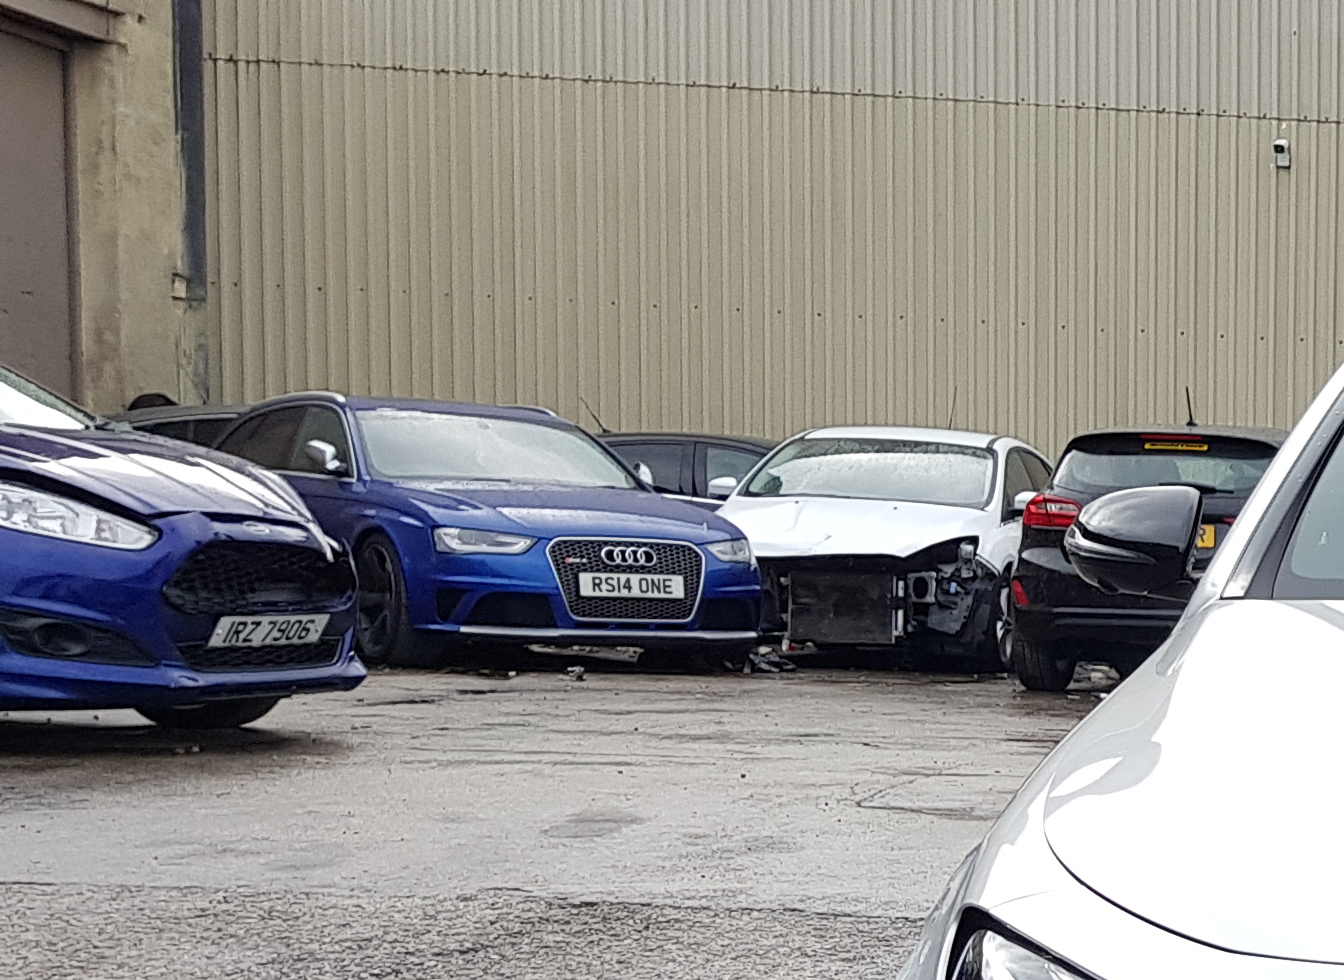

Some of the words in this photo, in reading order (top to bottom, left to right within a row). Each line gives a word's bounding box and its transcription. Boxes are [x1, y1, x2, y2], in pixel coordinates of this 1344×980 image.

[591, 576, 633, 594] RS14
[638, 577, 674, 595] ONE
[222, 620, 263, 643] IRZ
[260, 618, 316, 643] 7906
